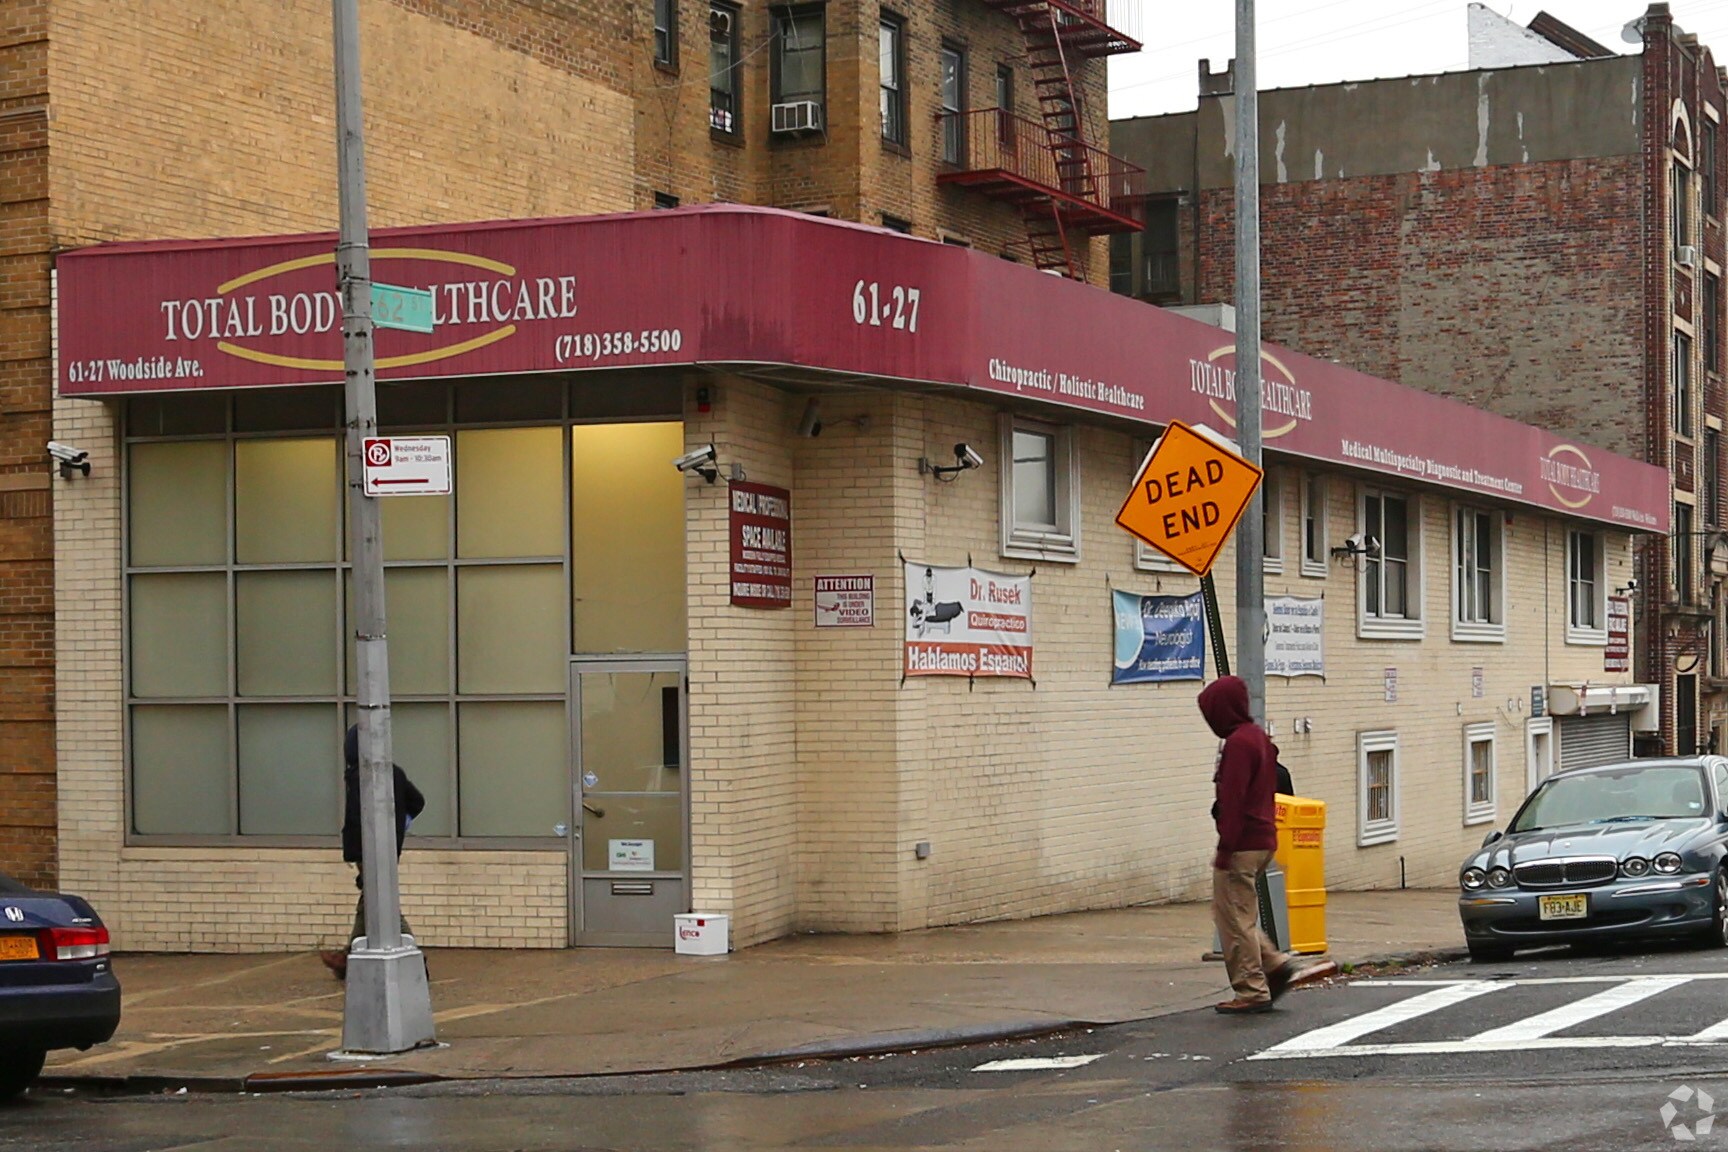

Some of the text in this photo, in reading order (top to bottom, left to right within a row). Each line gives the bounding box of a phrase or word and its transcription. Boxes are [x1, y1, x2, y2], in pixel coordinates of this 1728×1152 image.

[160, 296, 263, 340] TOTAL
[377, 290, 404, 322] 62
[852, 279, 920, 333] 61-27
[555, 329, 681, 363] (718)358-5500
[69, 356, 204, 382] 61-27 Woodside Ave.
[989, 358, 1052, 391] Chiropractic
[1059, 373, 1097, 399] Holistic
[1097, 382, 1144, 410] Healthcare
[1189, 358, 1225, 400] TOTAL
[1260, 379, 1312, 420] EALTHCARE
[394, 444, 431, 453] Wednesday
[1341, 438, 1373, 461] Medical
[1426, 459, 1461, 480] Diagnostic
[1461, 468, 1474, 484] and
[1474, 470, 1504, 490] Treatment
[1145, 459, 1224, 505] DEAD
[1162, 501, 1220, 540] END
[817, 578, 871, 591] ATTENTION
[970, 578, 1021, 605] Dr. Rusek
[839, 608, 869, 616] VIDEO
[908, 646, 976, 671] Hablamos
